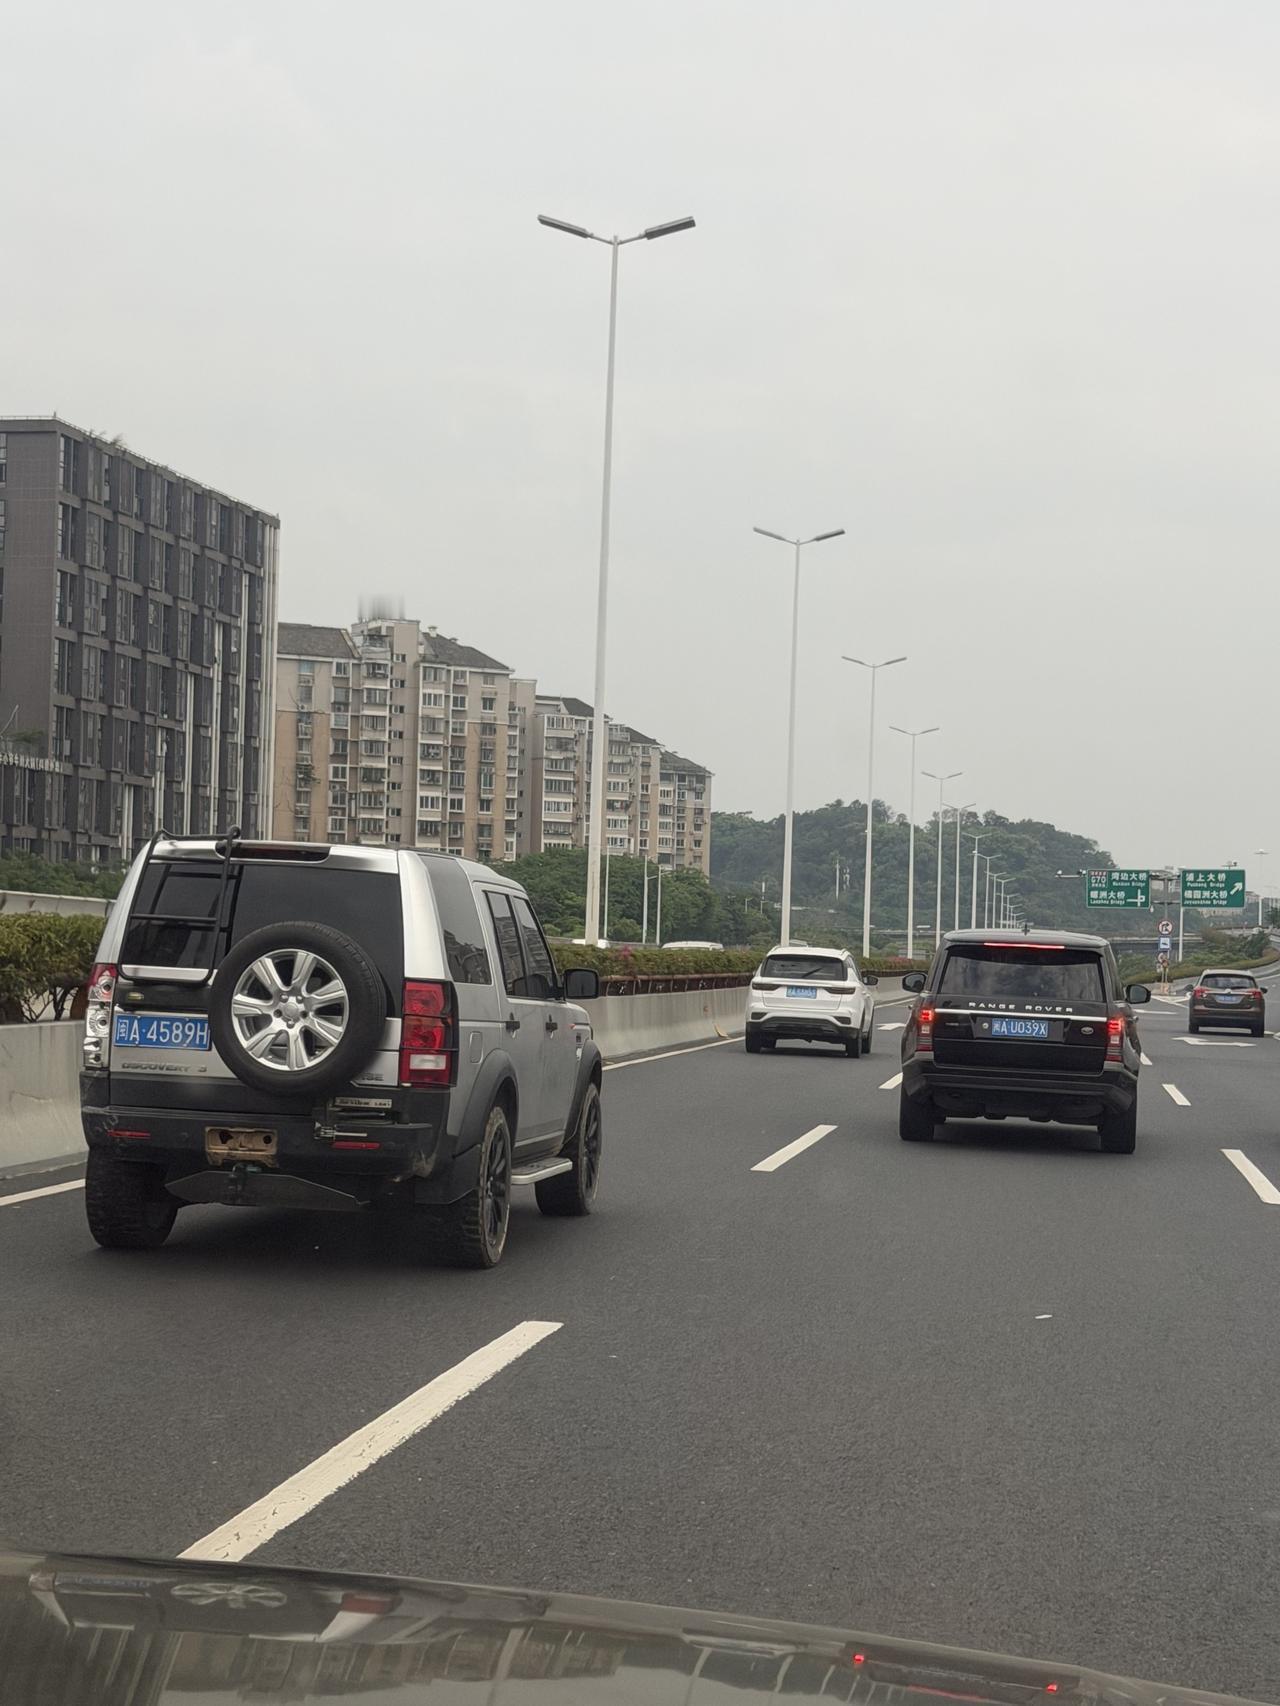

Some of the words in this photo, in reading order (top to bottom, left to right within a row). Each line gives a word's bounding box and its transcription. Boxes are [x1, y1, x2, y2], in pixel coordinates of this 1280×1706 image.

[1185, 872, 1226, 882] 浦上大桥
[968, 1001, 1016, 1010] RANGE
[1025, 1004, 1073, 1013] ROVER
